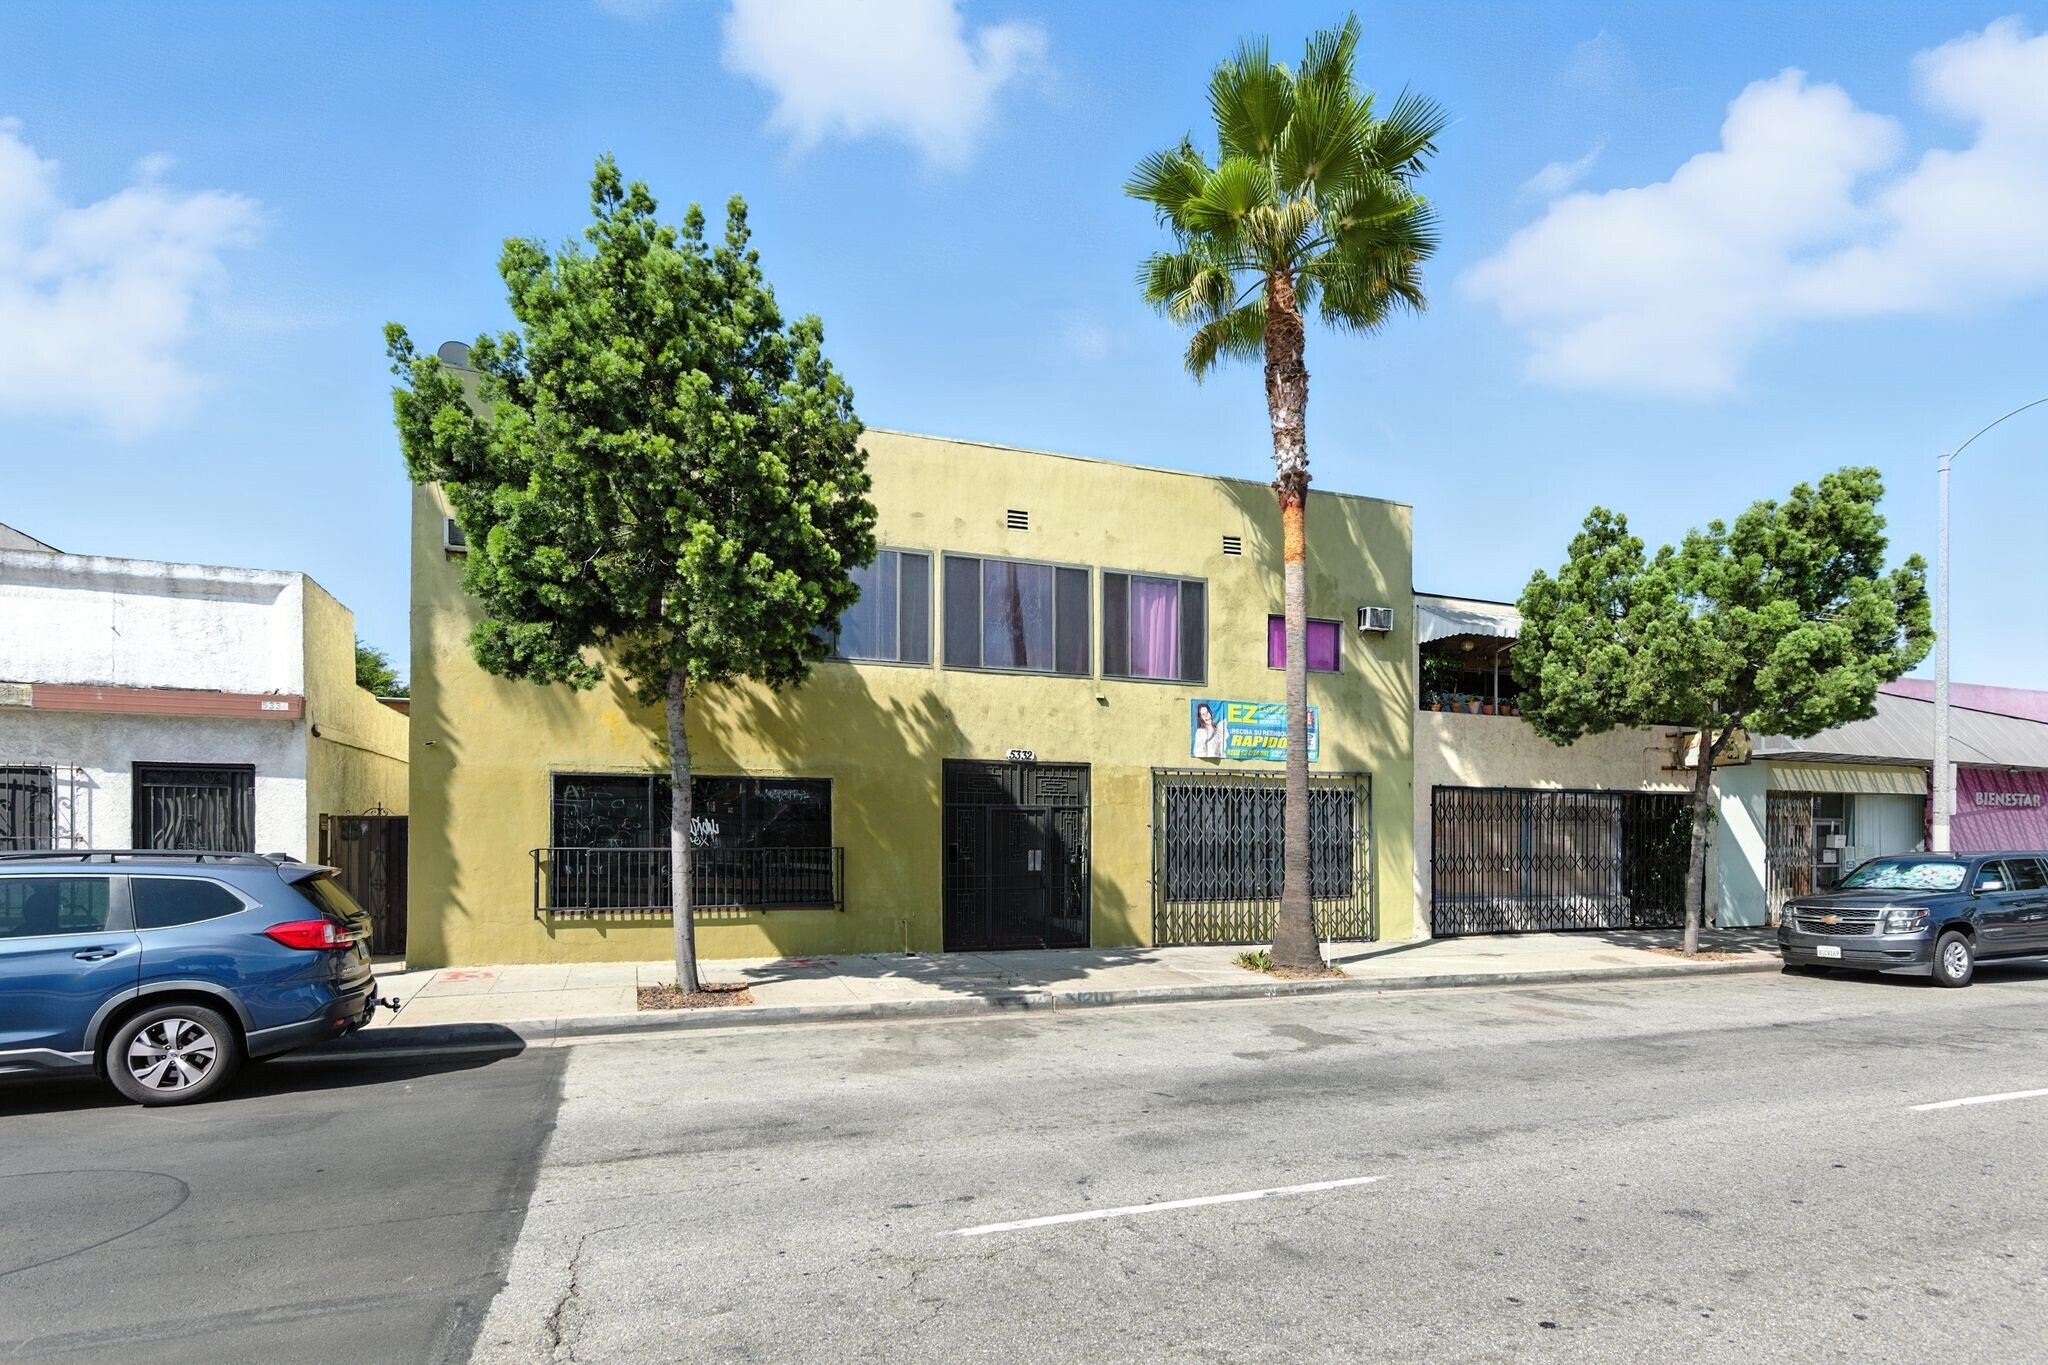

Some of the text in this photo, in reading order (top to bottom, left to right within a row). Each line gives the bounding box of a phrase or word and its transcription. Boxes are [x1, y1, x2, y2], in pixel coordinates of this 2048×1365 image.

[1227, 703, 1258, 724] EZ
[1231, 735, 1288, 748] RAPIDO
[1009, 749, 1033, 760] 5332
[1975, 791, 2041, 808] BIENESTAR
